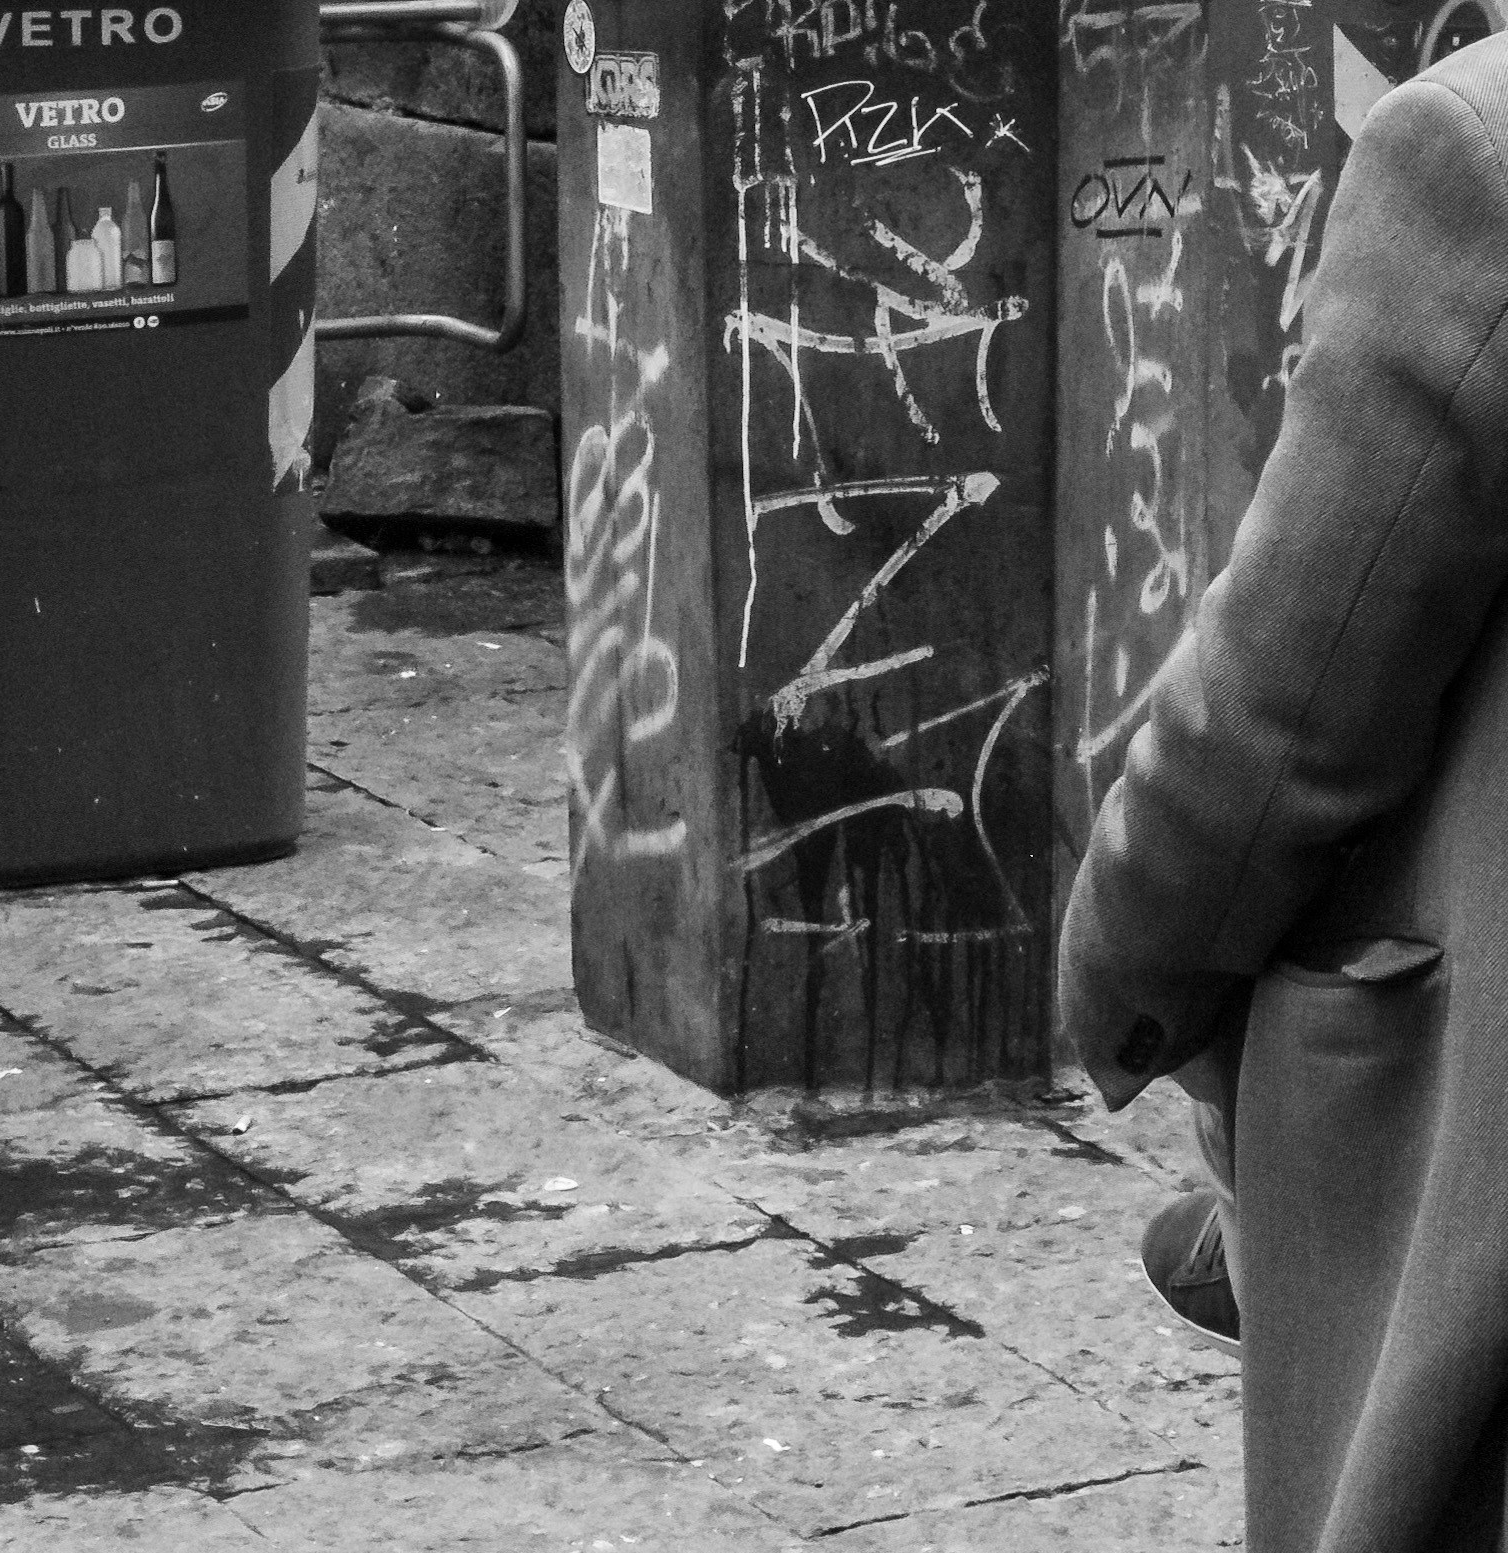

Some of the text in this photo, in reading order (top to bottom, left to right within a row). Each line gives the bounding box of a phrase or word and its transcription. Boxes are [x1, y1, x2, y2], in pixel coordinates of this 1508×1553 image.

[15, 96, 126, 128] VETRO
[47, 134, 97, 149] GLASS
[131, 293, 175, 305] barattoli
